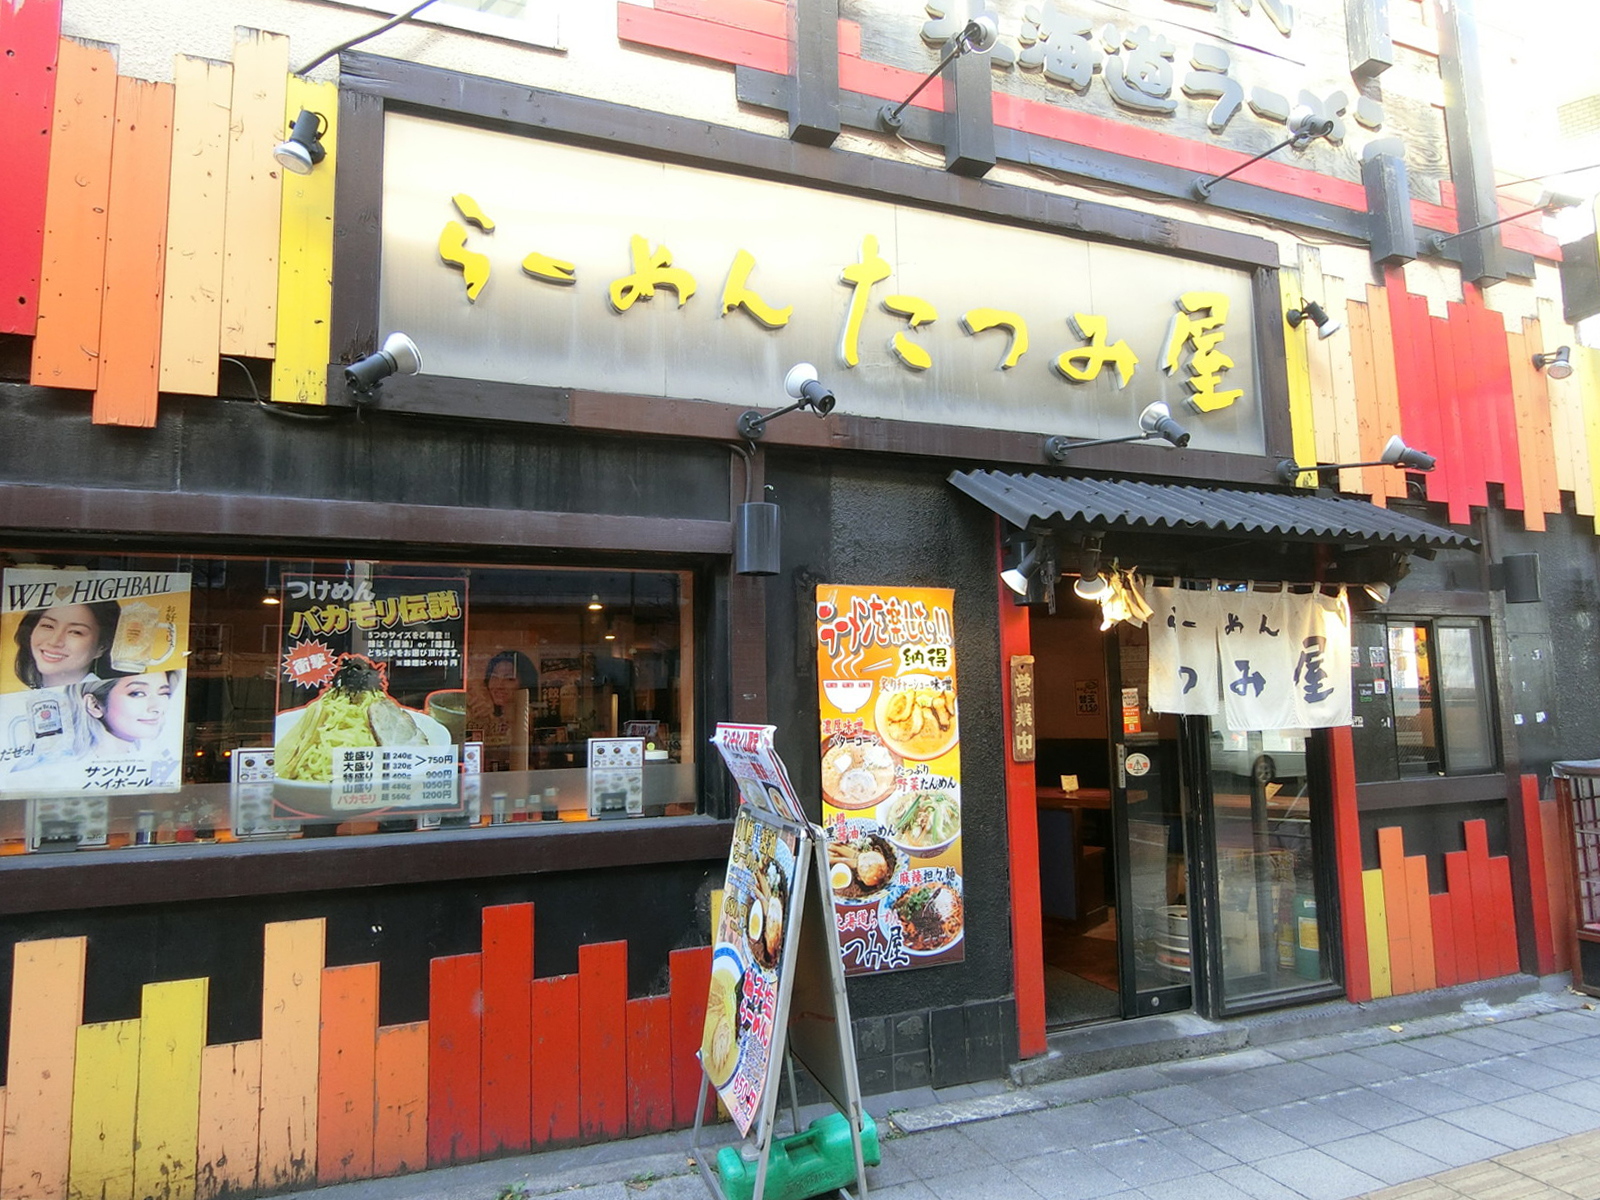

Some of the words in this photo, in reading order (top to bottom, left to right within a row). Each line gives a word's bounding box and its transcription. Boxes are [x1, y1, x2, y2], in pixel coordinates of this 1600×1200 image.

[838, 231, 1245, 414] たつみ屋
[8, 582, 57, 611] WE
[69, 574, 172, 604] HIGHBALL
[286, 580, 376, 601] つけめん
[288, 589, 462, 639] バカモリ伝説
[817, 594, 952, 657] ラーメンを楽しむ!!
[292, 652, 329, 675] 衝撃
[902, 647, 948, 668] 納得
[1014, 673, 1034, 755] 営業中
[822, 719, 864, 734] 濃厚味噌
[828, 735, 882, 748] バターコーン
[343, 751, 375, 762] 並盛り
[392, 752, 412, 760] 240g
[427, 755, 453, 764] 750円
[85, 765, 147, 779] サントリー
[342, 772, 374, 783] 特盛り
[425, 769, 452, 779] 900円
[343, 762, 374, 773] 大盛り
[392, 762, 412, 770] 320g
[82, 777, 154, 790] ハイボール
[342, 783, 374, 794] 山盛り
[391, 782, 411, 791] 480g
[422, 781, 452, 790] 1050円
[896, 777, 957, 792] 野菜たんめん
[337, 793, 376, 805] バカモリ
[391, 792, 411, 801] 560g
[422, 790, 452, 800] 1200円
[825, 812, 846, 827] 小樽
[824, 824, 897, 842] 黒醤油らーめん
[898, 866, 957, 884] 麻辣担々麺
[840, 925, 911, 970] つみ屋
[738, 997, 768, 1050] らーめん
[732, 1071, 757, 1122] 650円
